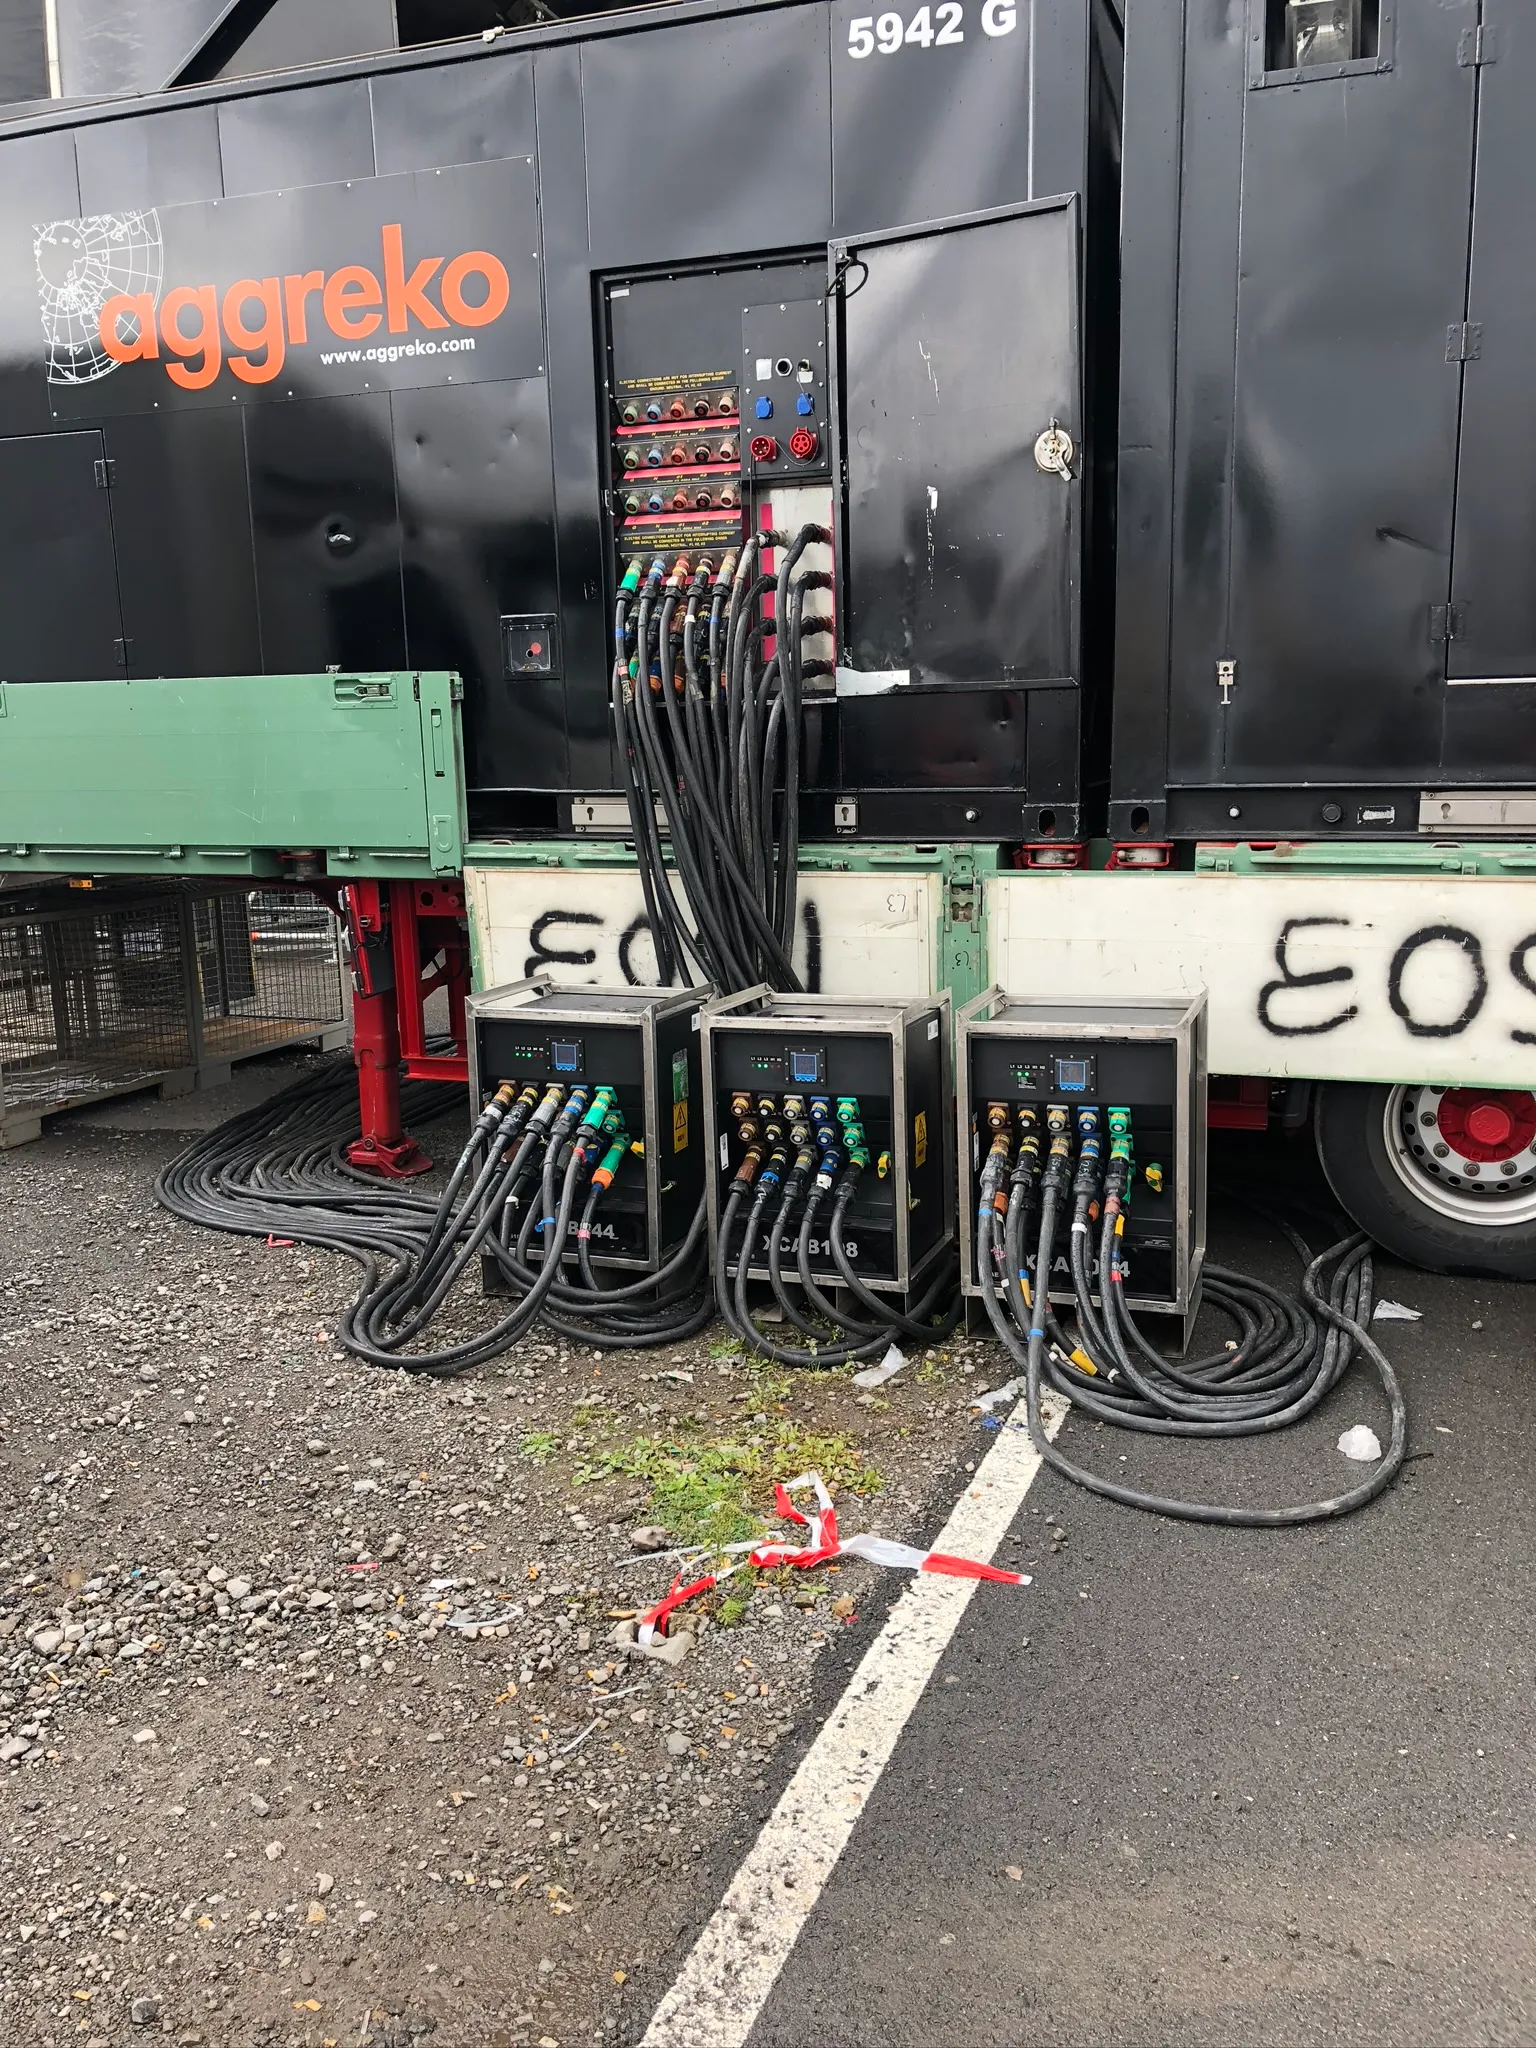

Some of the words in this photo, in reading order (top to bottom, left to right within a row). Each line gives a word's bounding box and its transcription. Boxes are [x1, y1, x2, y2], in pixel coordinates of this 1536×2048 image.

[848, 2, 964, 59] 5942
[981, 0, 1017, 37] G
[100, 224, 509, 390] aggreko
[320, 336, 475, 365] www.aggreko.com
[762, 1235, 858, 1258] XCAB18
